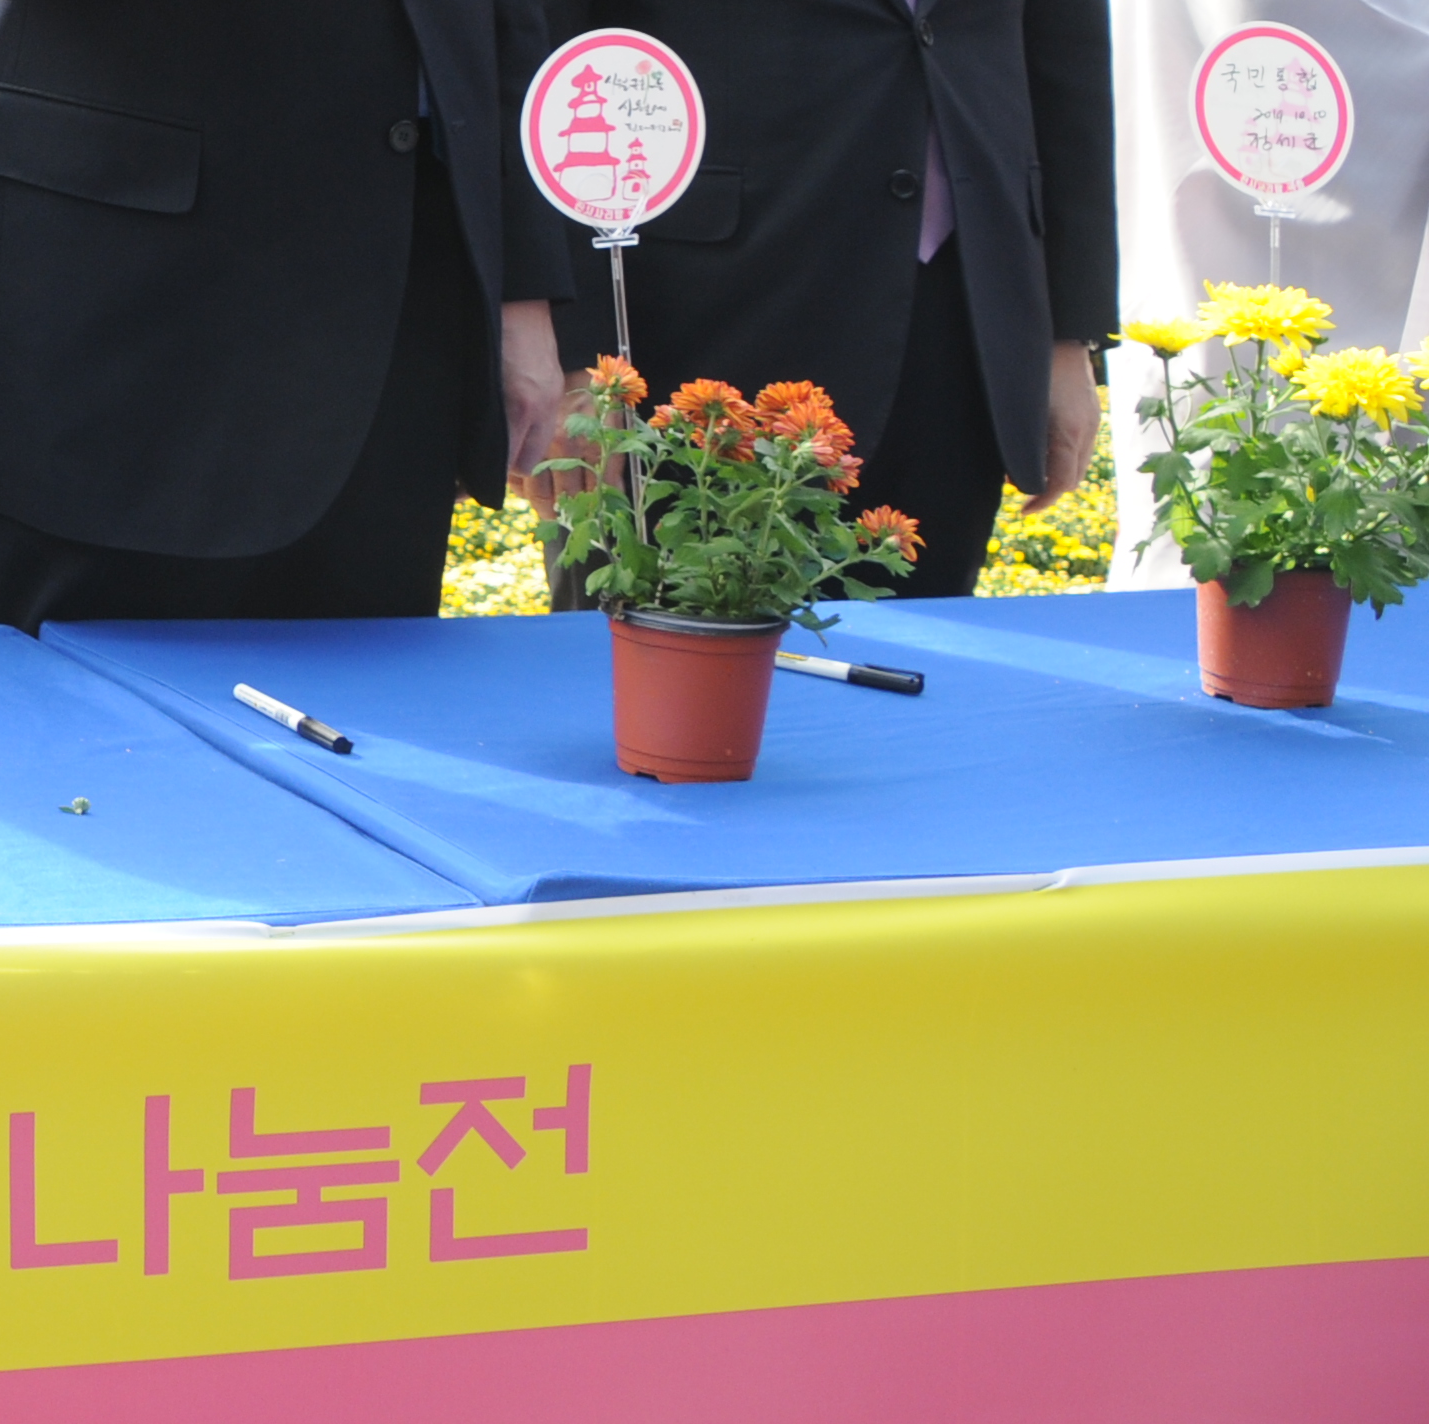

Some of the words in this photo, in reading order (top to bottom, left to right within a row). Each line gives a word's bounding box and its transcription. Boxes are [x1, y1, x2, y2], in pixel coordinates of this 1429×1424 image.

[1221, 63, 1266, 93] 국민
[1276, 67, 1318, 92] 통합
[9, 1062, 593, 1282] 나눔전
